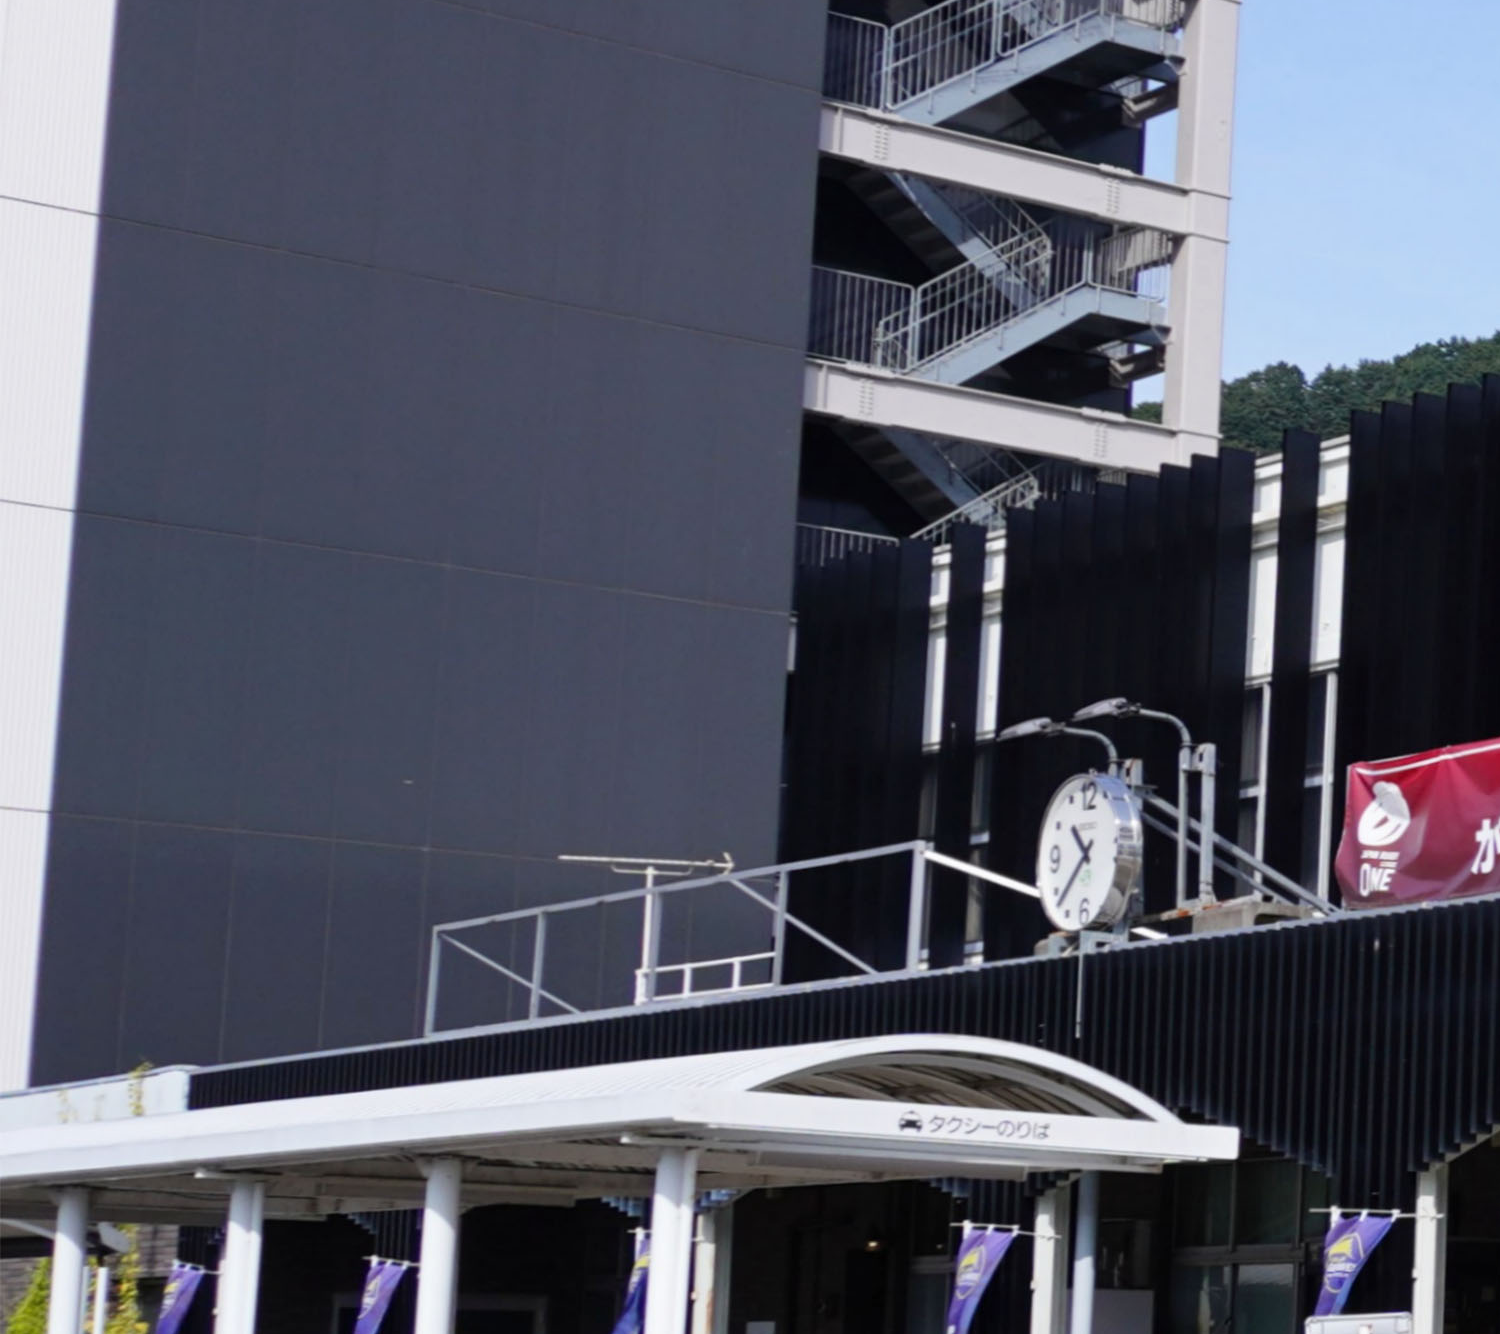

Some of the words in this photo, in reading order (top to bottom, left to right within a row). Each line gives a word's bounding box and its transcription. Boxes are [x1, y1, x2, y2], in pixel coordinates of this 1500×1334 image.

[1081, 781, 1098, 811] 12
[1050, 844, 1061, 874] 9
[1360, 862, 1396, 897] ONE
[1079, 898, 1090, 926] 6
